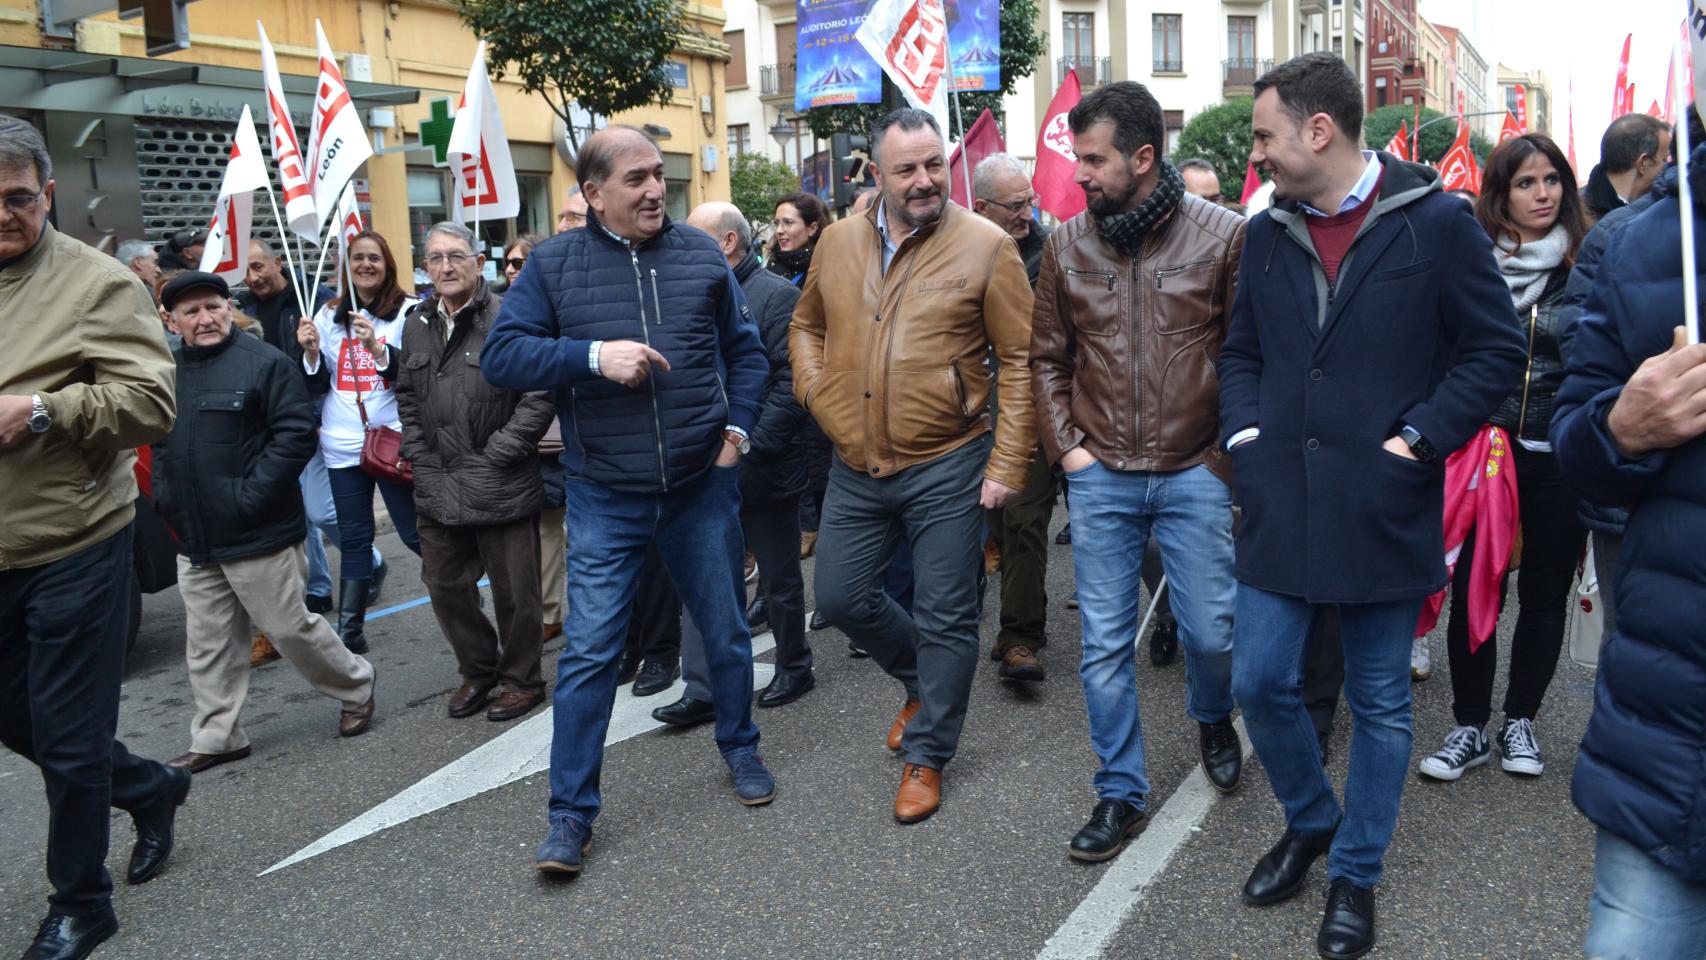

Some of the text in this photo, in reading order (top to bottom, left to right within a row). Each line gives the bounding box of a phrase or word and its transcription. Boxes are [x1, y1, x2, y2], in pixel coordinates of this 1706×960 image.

[801, 13, 868, 34] AUDITORIO LEÓ
[318, 137, 344, 181] León
[370, 381, 385, 391] YA
